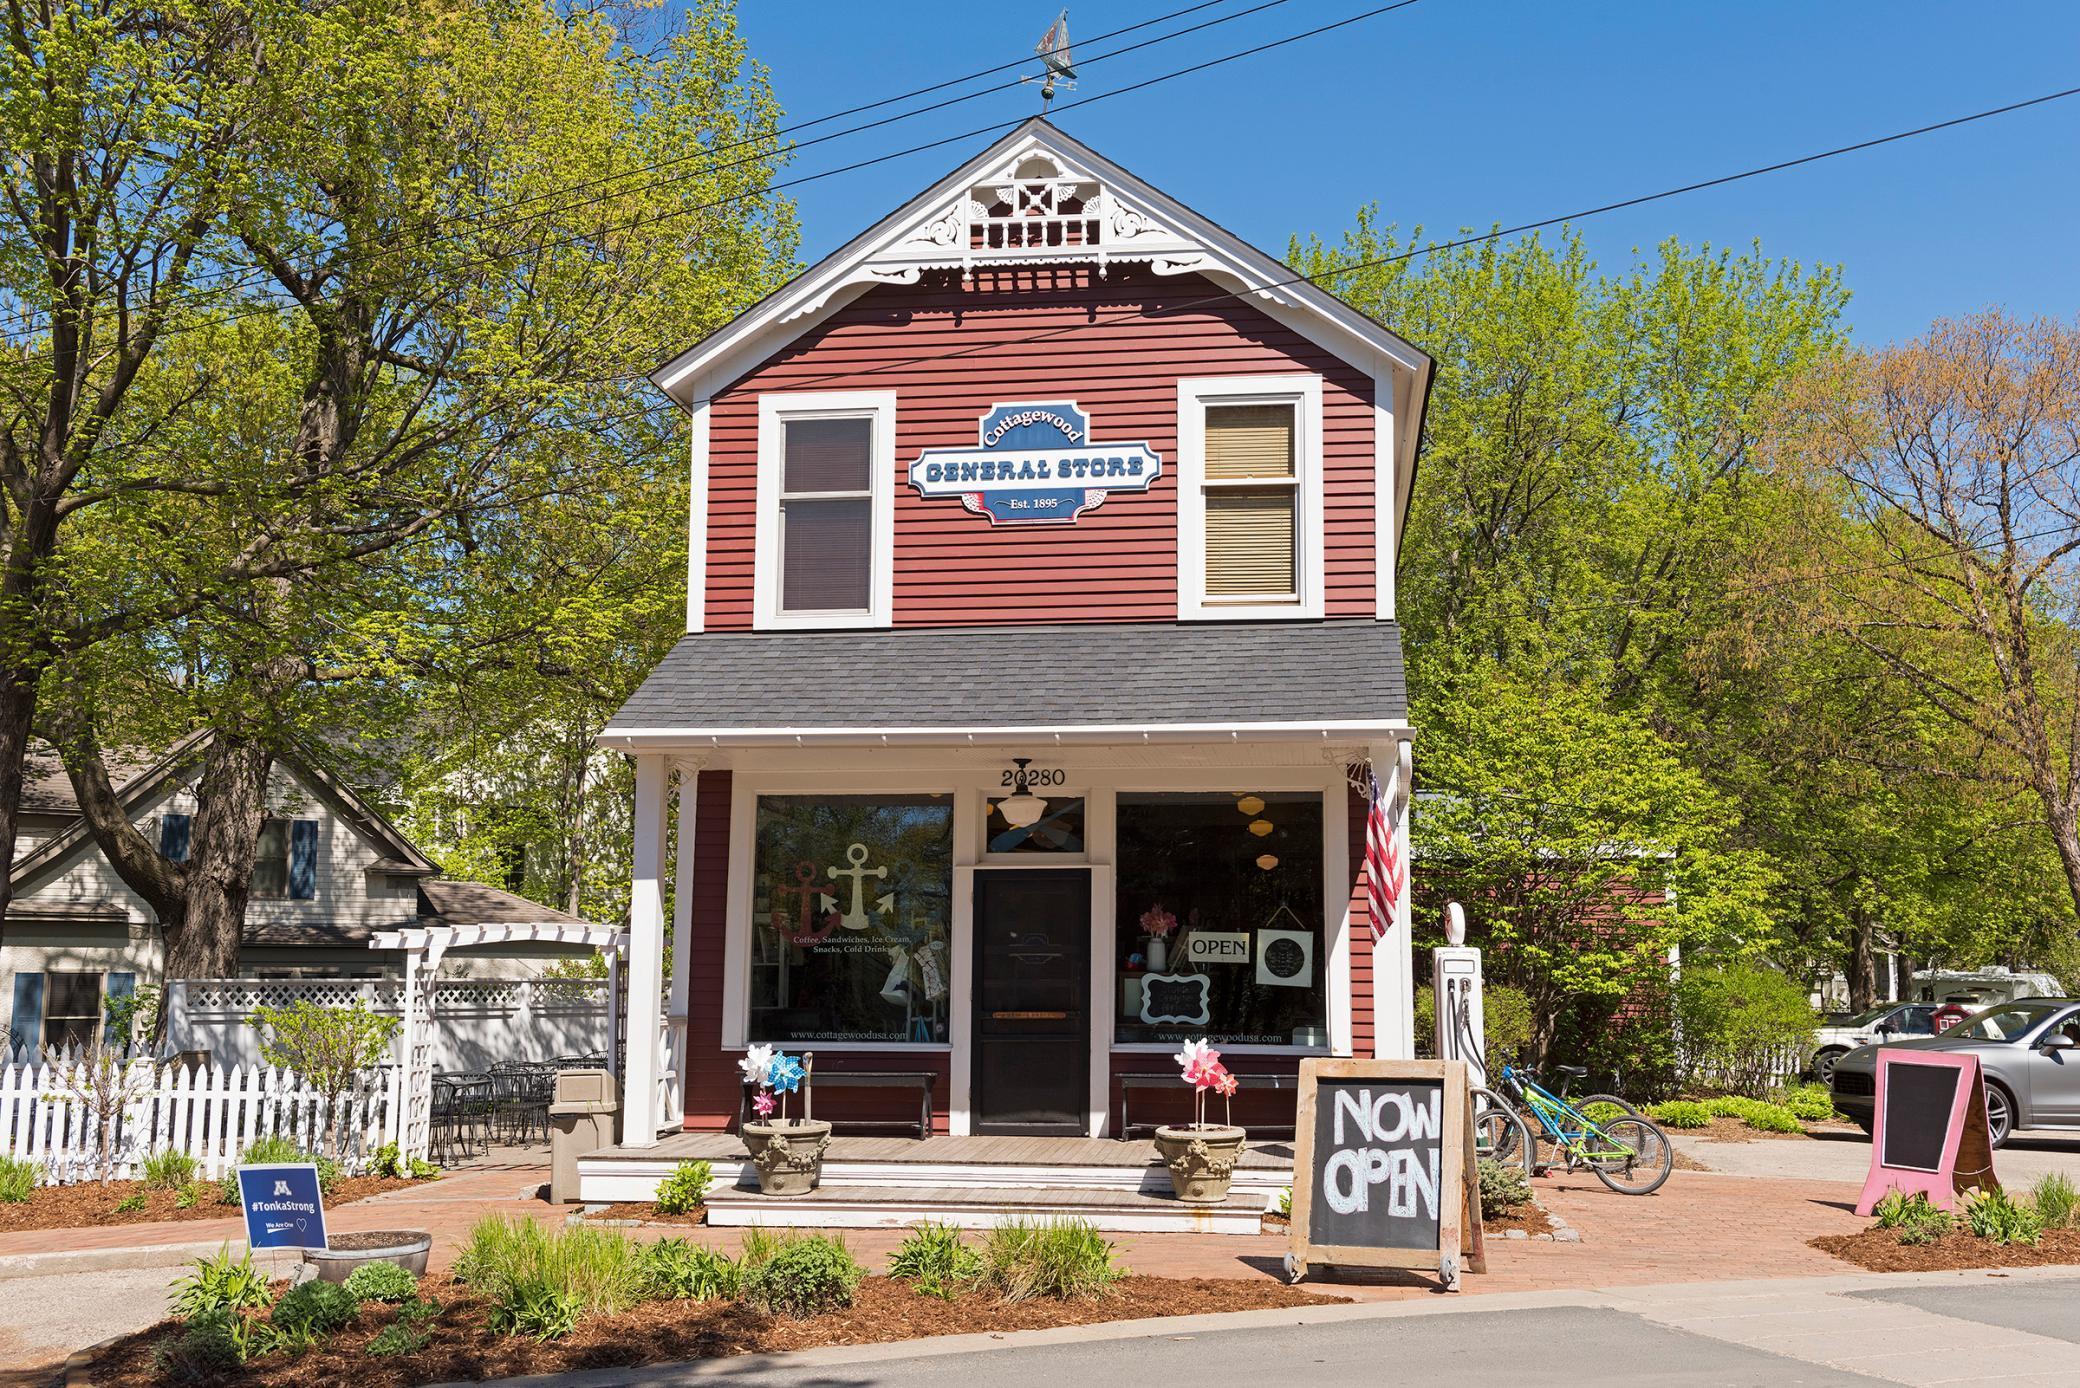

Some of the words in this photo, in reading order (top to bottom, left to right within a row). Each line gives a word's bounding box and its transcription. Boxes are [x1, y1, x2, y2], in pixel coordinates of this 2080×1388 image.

[984, 410, 1083, 447] Cottagewood
[925, 459, 1051, 483] GENERAL
[1057, 456, 1144, 479] STORE
[1010, 498, 1031, 510] Est.
[1033, 497, 1058, 509] 1895
[1001, 768, 1065, 787] 20280
[793, 936, 820, 944] Coffee,
[822, 935, 869, 944] Sandwiches,
[872, 935, 883, 943] Ice
[884, 935, 912, 944] Cream,
[1192, 939, 1246, 955] OPEN
[813, 945, 842, 954] Snacks,
[844, 945, 862, 953] Cold
[790, 1030, 909, 1041] www.cottagewoodusa.com
[1333, 1088, 1442, 1146] NOW
[1323, 1147, 1441, 1221] OPEN
[251, 1201, 315, 1214] #TonkaStrong
